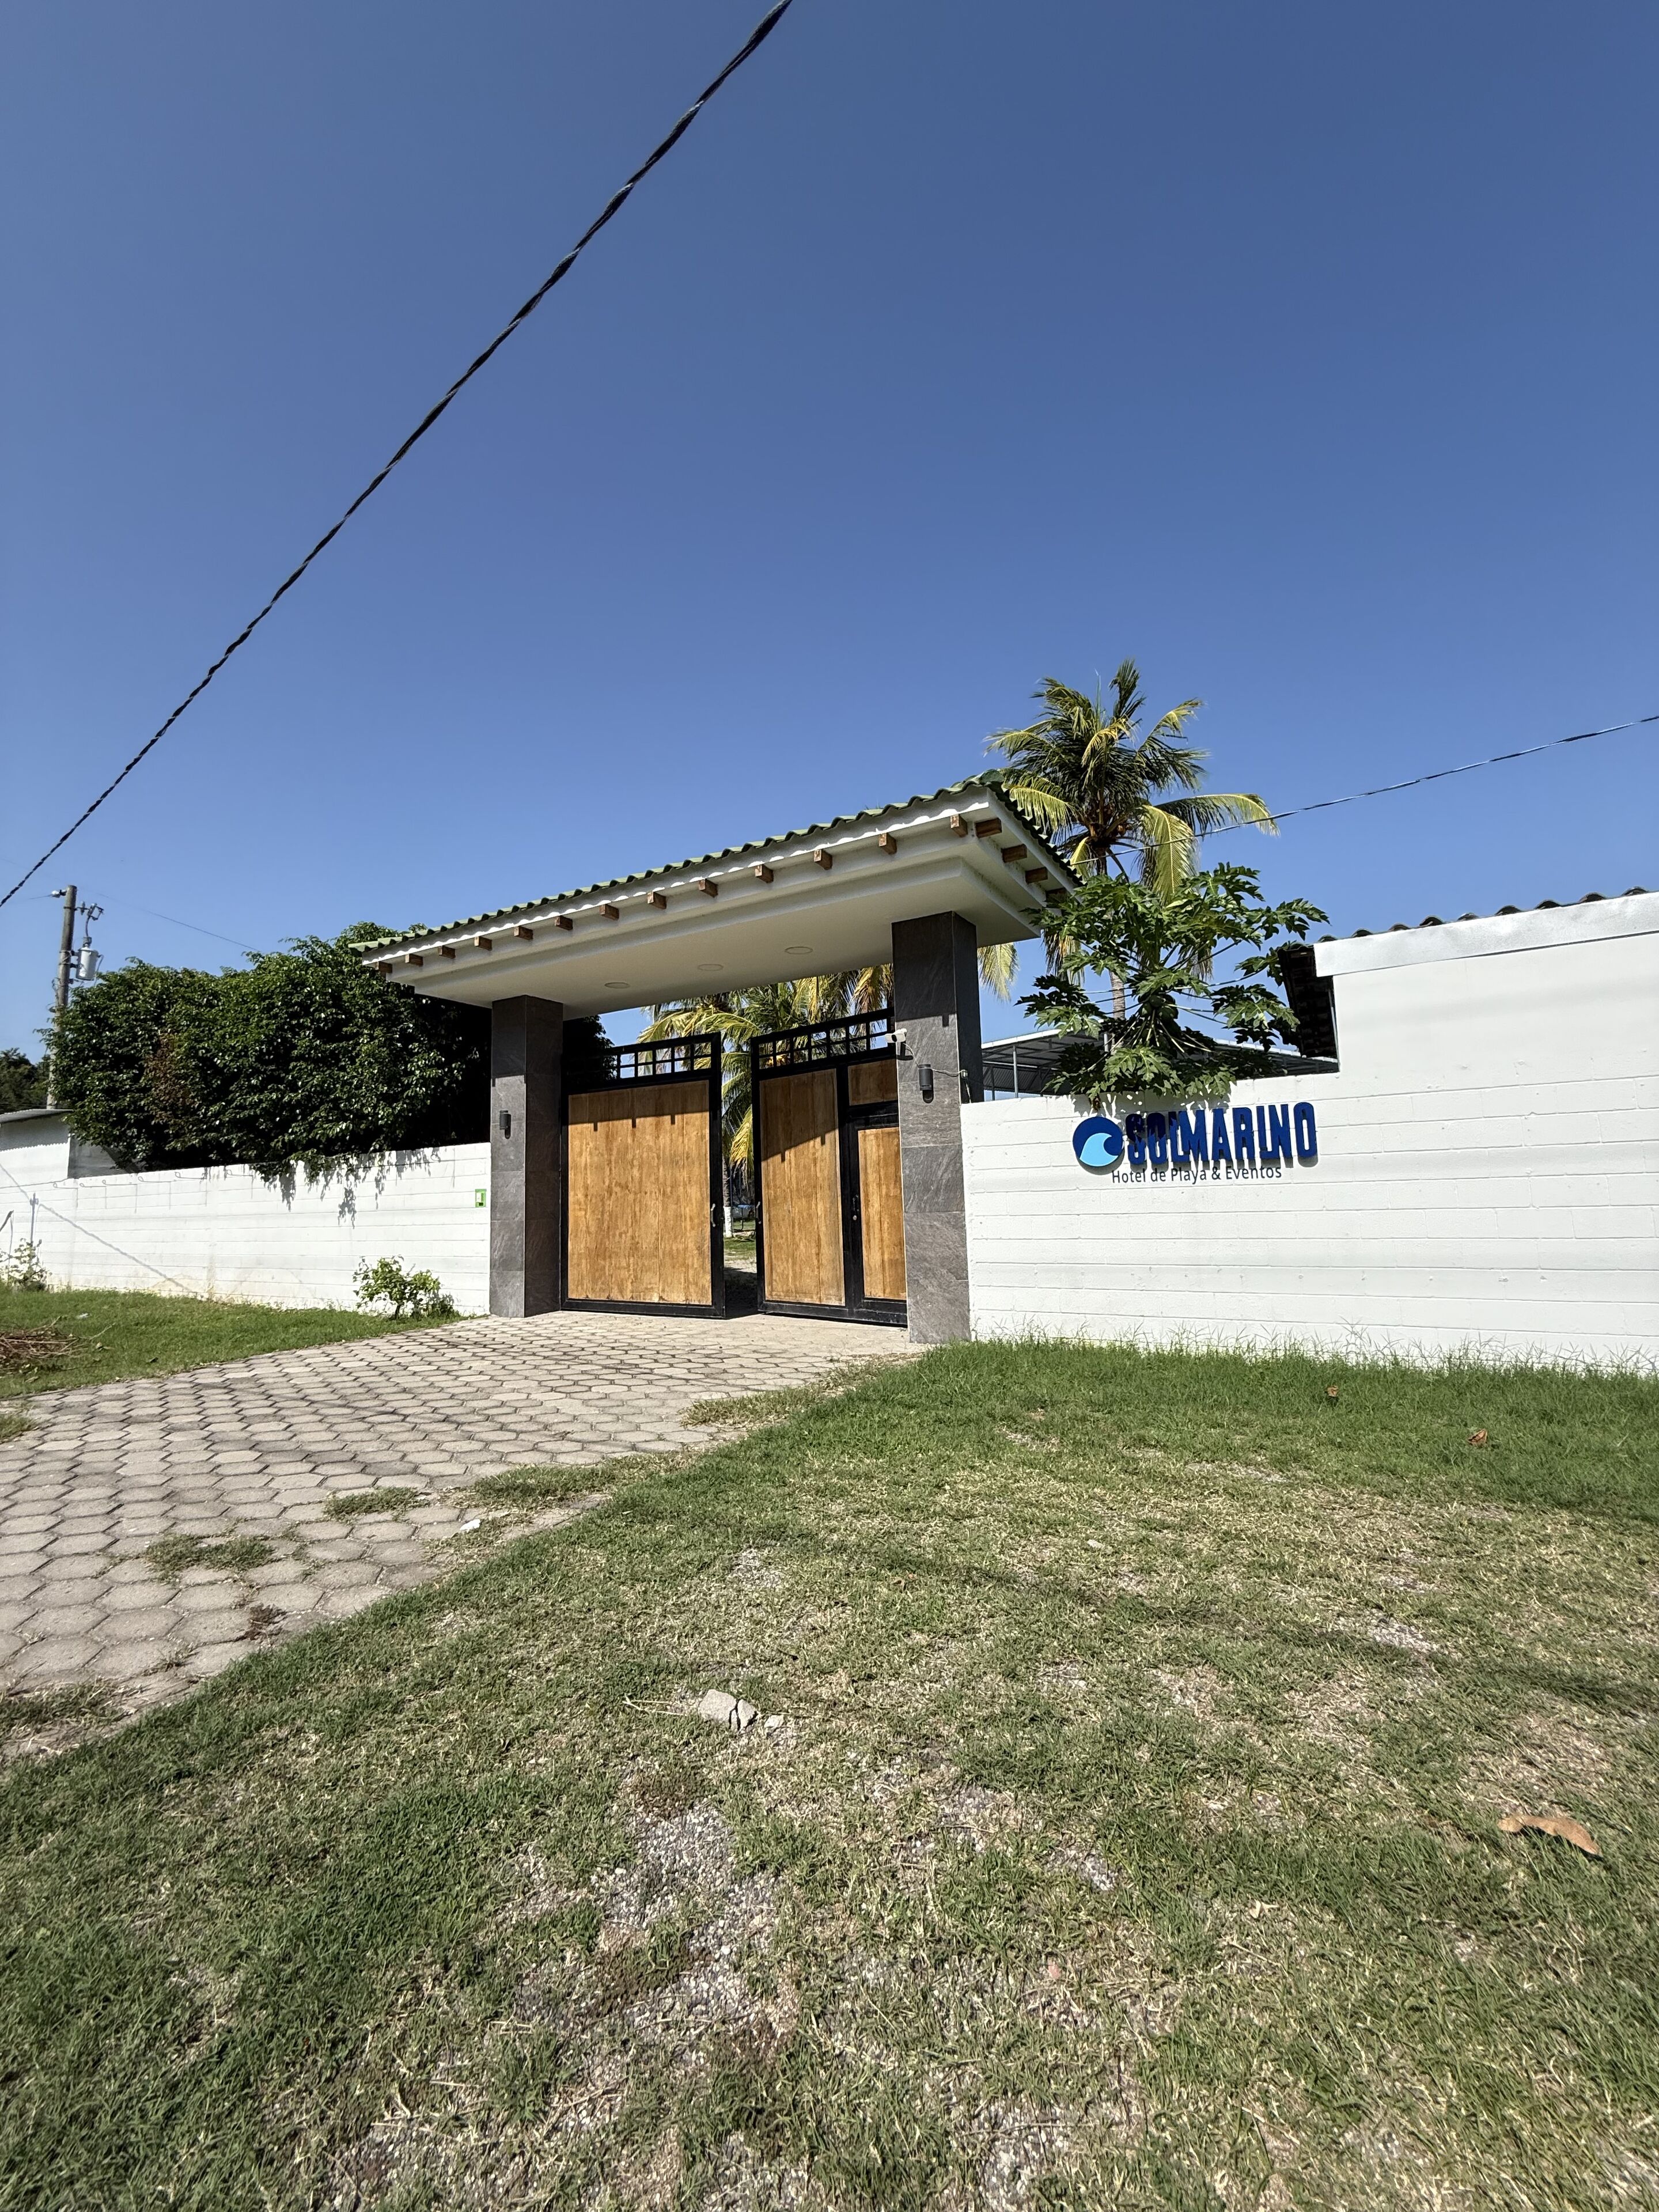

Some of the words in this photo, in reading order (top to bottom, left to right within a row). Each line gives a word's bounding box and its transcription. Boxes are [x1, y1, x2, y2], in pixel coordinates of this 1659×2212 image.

[1125, 1101, 1317, 1165] SOLMARINO
[1112, 1168, 1146, 1184] Hotel
[1150, 1167, 1166, 1182] de
[1171, 1167, 1207, 1185] Playa
[1211, 1166, 1221, 1180] &
[1225, 1165, 1282, 1180] Eventos
